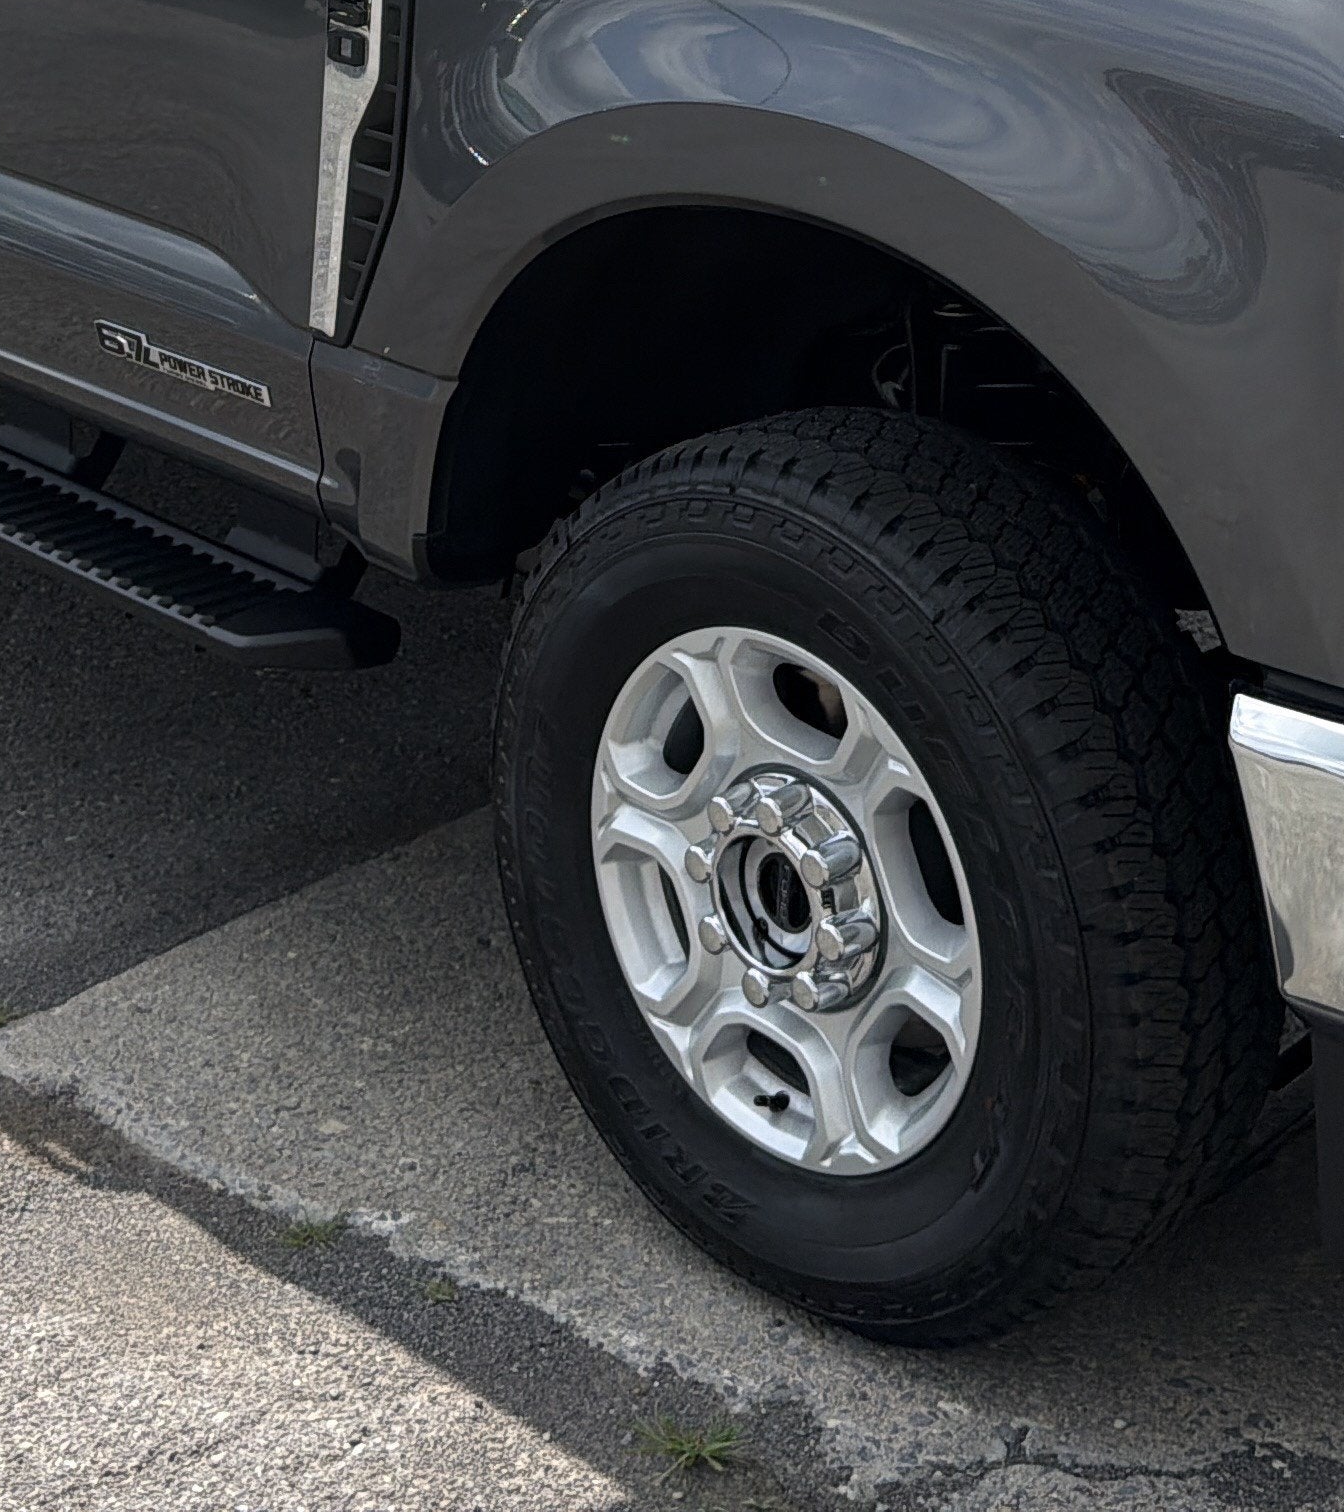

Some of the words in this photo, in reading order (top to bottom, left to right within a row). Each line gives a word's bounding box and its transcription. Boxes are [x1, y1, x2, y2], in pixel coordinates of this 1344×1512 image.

[95, 321, 160, 370] 6.7L
[159, 352, 206, 382] POWER
[207, 370, 266, 404] STROKE
